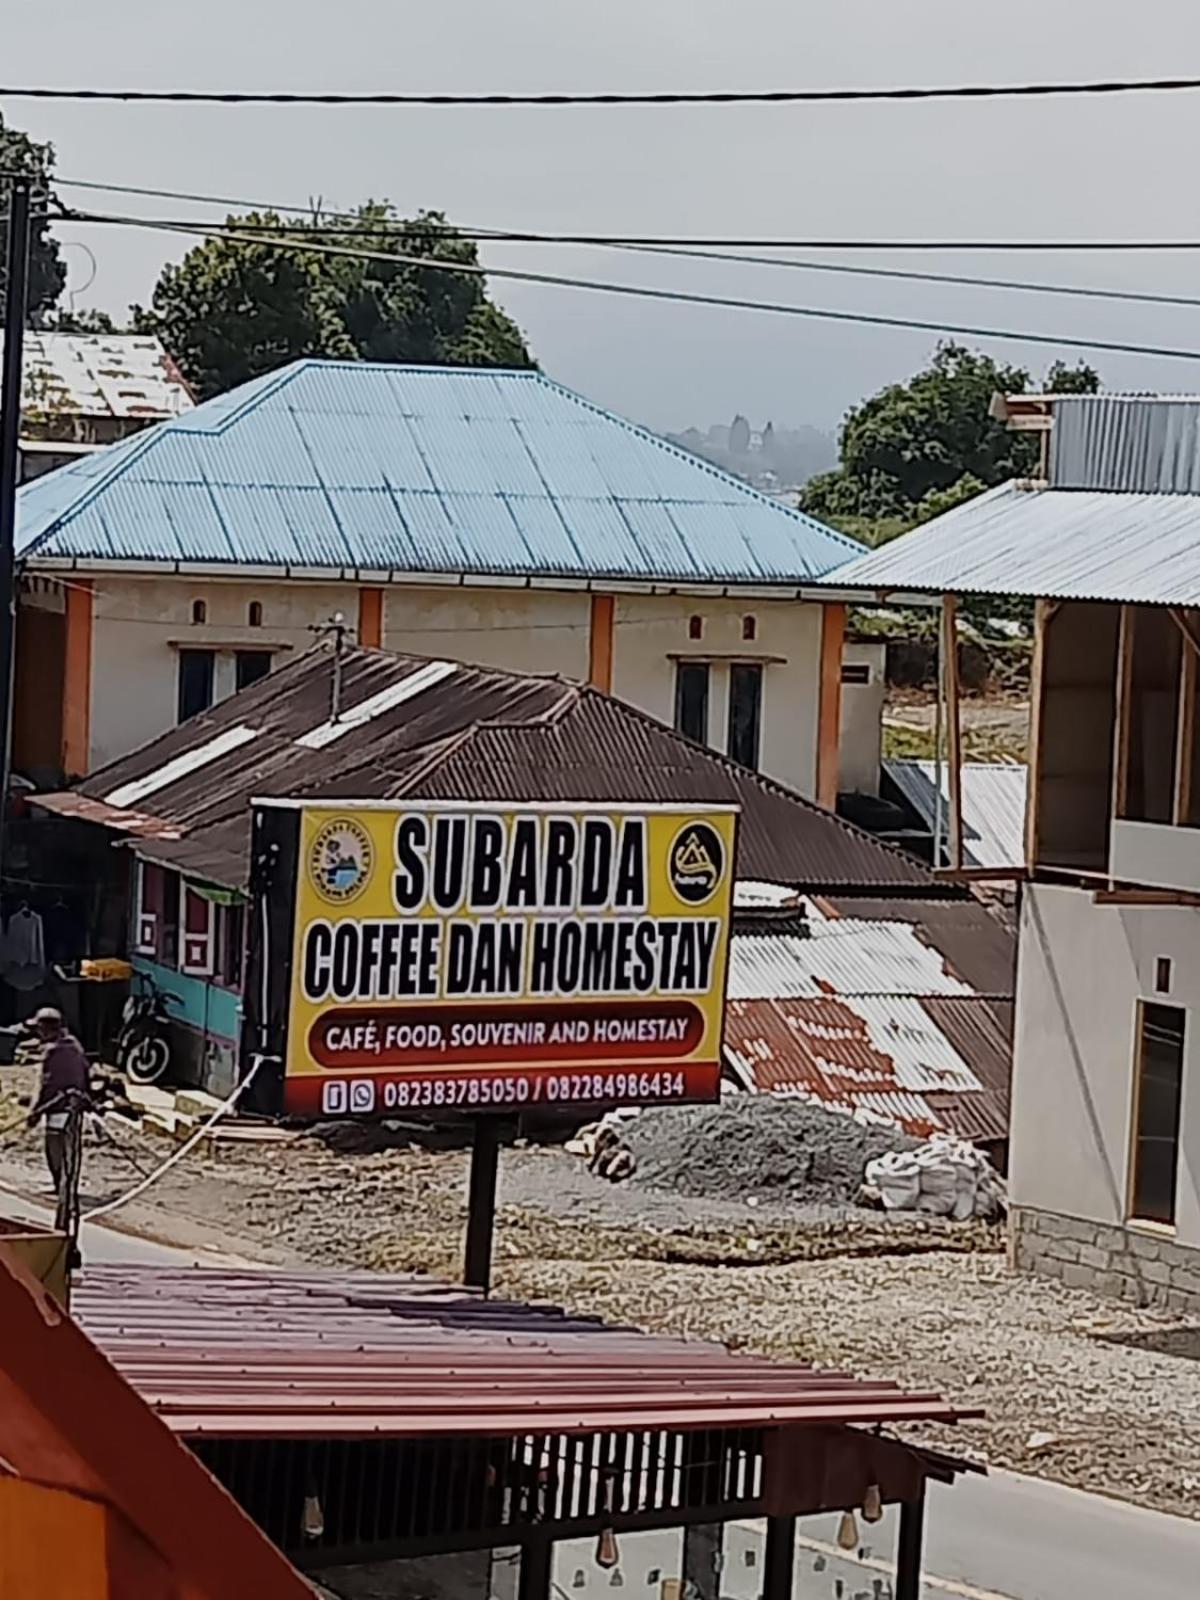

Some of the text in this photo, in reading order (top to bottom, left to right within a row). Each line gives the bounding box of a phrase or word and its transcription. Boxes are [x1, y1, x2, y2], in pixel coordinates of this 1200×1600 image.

[394, 815, 646, 911] SUBARDA
[304, 919, 718, 999] COFFEE DAN HOMESTAY
[326, 1017, 688, 1054] CAFÉ, FOOD, SOUVENIR AND HOMESTAY
[384, 1077, 528, 1107] 082383785050
[547, 1071, 684, 1101] 082284986434
